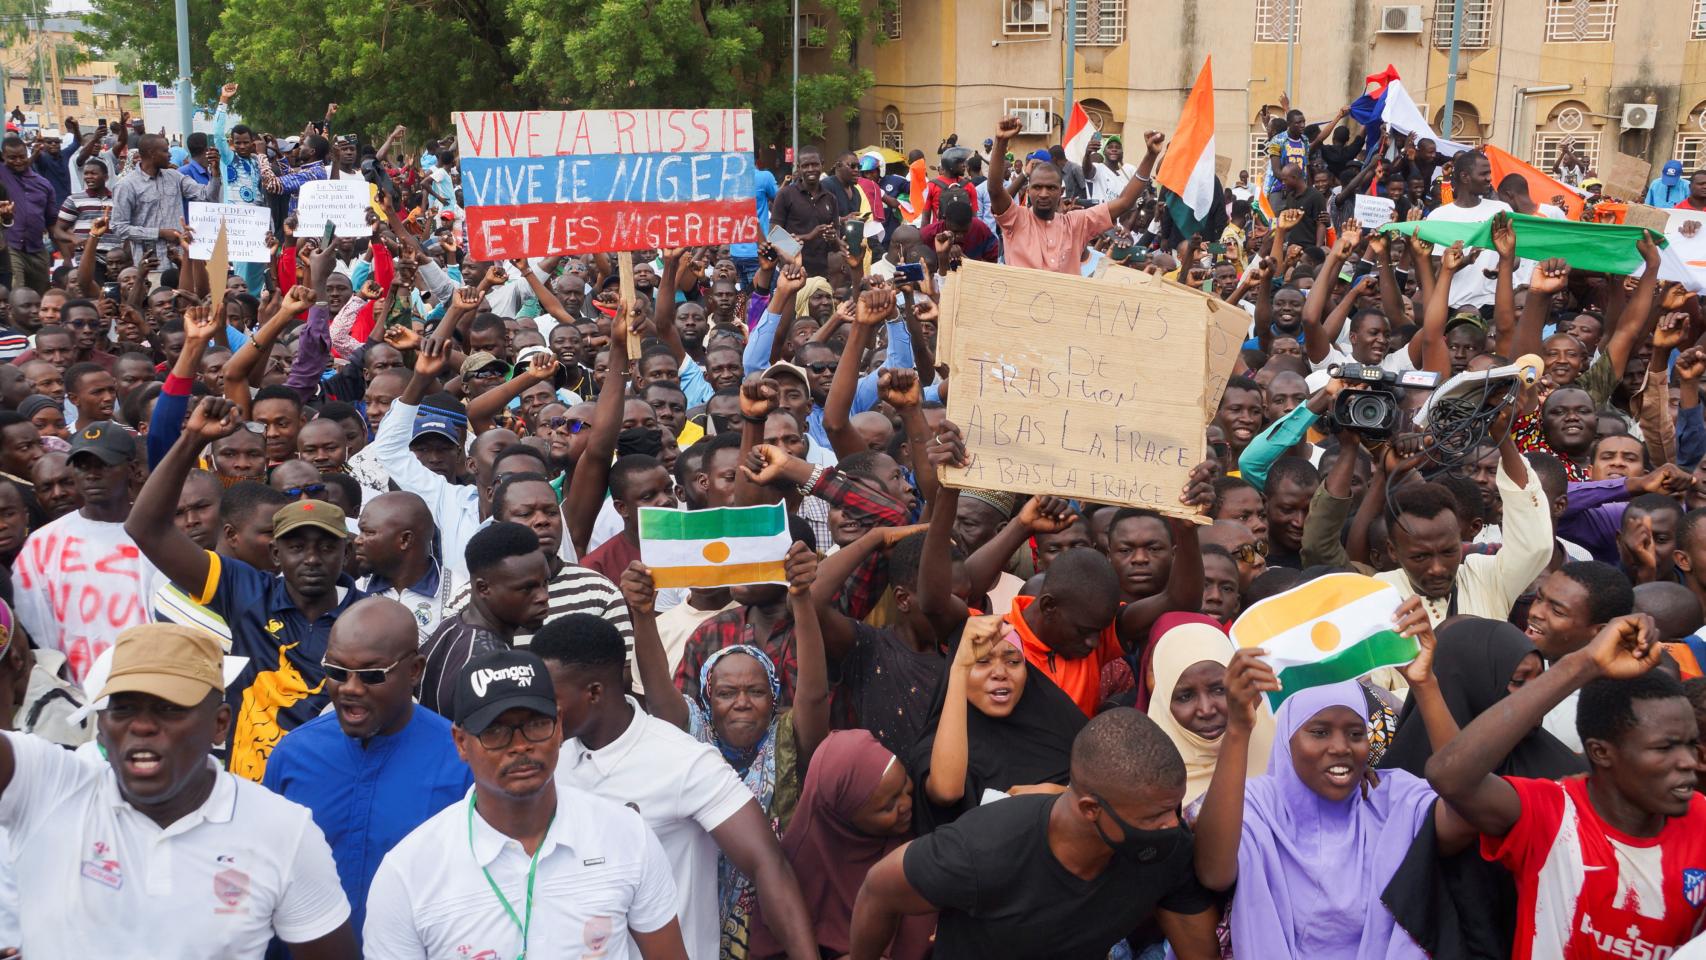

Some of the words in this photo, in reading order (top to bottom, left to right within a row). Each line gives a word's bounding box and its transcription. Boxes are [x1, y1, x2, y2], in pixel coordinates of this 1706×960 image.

[460, 111, 544, 158] VIVE
[556, 110, 592, 156] LA
[612, 109, 752, 154] RUSSIE
[463, 164, 545, 206] VIVE
[555, 159, 592, 203] LE
[607, 153, 754, 203] NIGER
[217, 206, 256, 215] CEDEAO
[481, 217, 539, 257] ET
[547, 216, 602, 254] LES
[610, 209, 758, 248] NIGERIENS
[991, 281, 1055, 328] 20
[1085, 295, 1168, 340] ANS
[964, 404, 985, 448] A
[993, 413, 1046, 445] BAS
[1090, 473, 1162, 503] FRANCE
